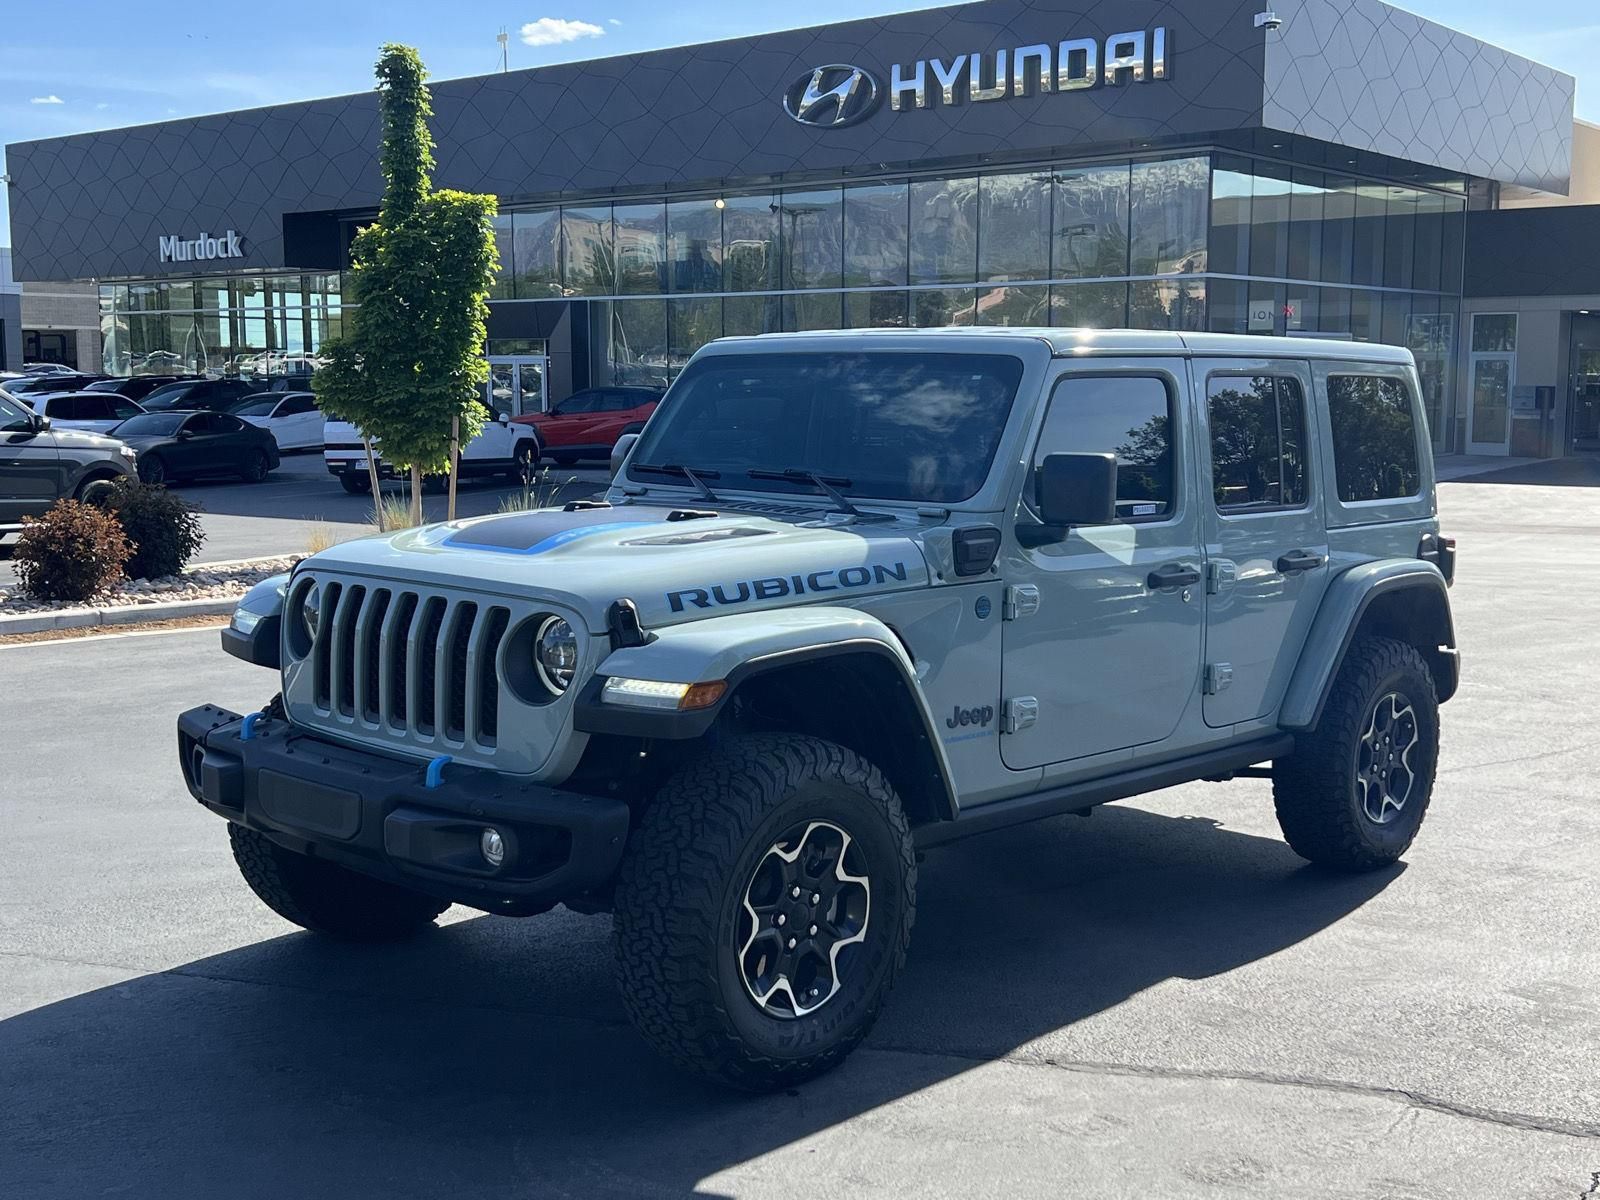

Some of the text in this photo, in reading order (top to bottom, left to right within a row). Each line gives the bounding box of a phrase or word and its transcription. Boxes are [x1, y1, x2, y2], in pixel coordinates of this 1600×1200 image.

[889, 27, 1168, 111] HYUNDAI
[159, 230, 243, 262] Murdock
[666, 562, 907, 612] RUBICON
[946, 706, 993, 728] Jeep
